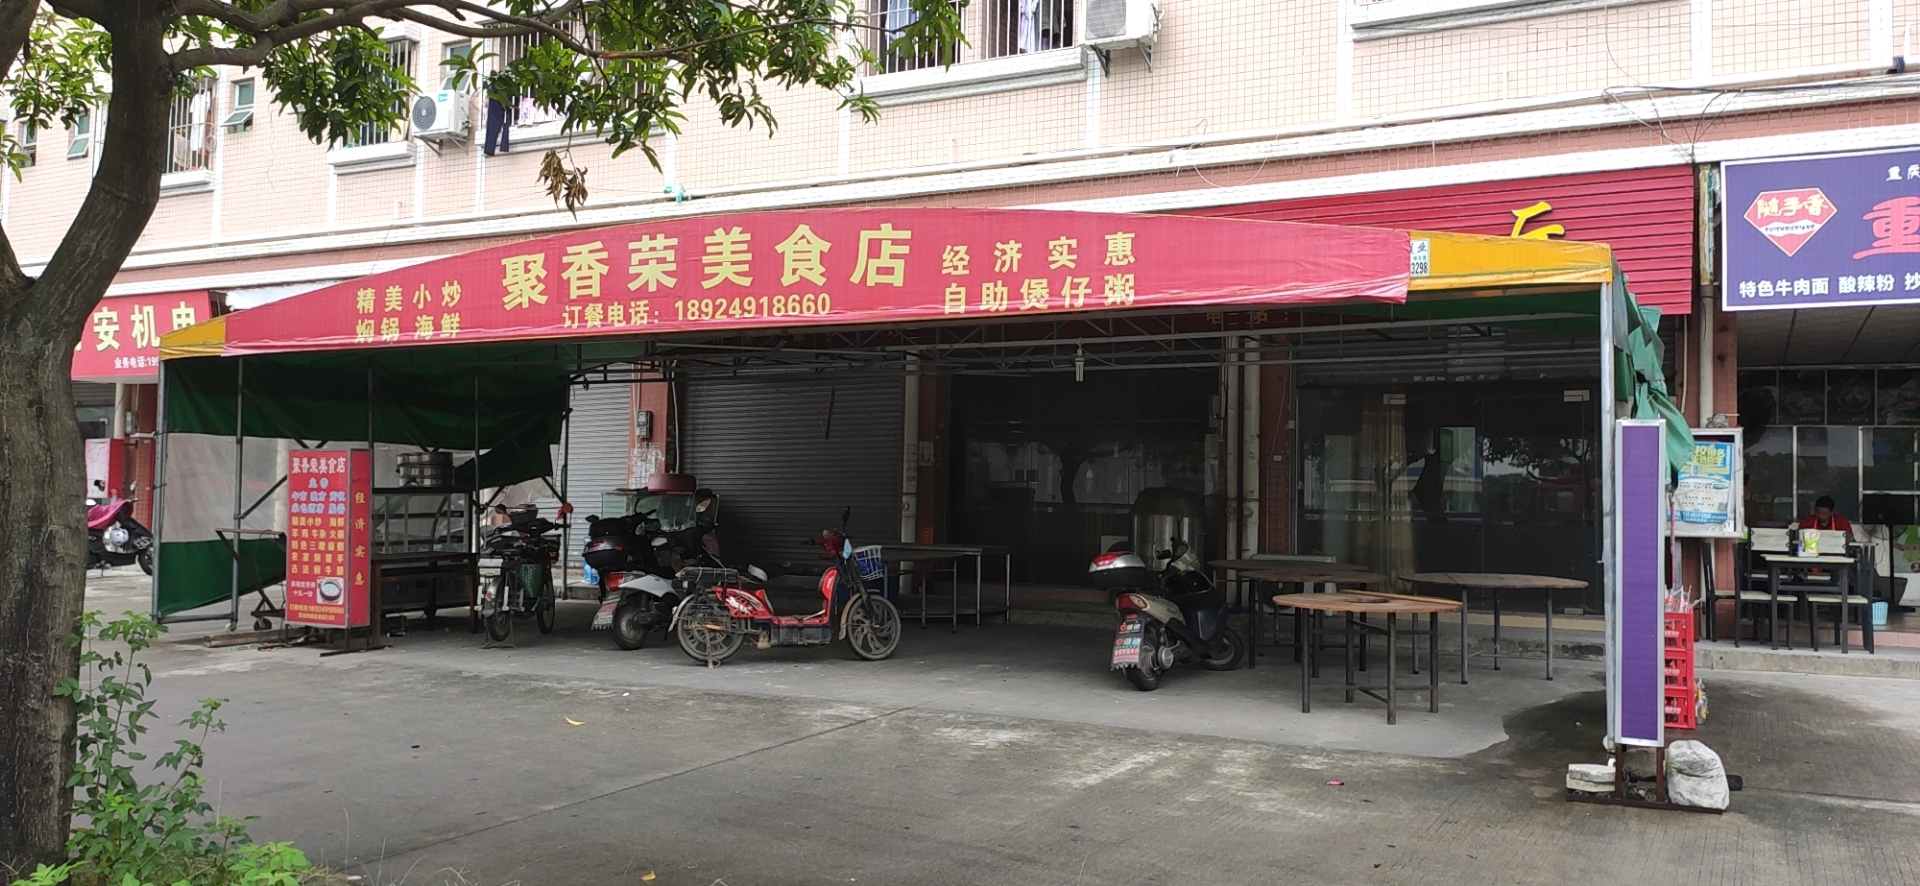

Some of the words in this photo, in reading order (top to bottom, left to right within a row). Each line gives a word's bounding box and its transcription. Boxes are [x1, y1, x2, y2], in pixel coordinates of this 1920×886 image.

[1757, 193, 1828, 219] 随手香
[501, 222, 912, 311] 聚香荣美食店
[941, 230, 1136, 276] 经济实惠
[356, 280, 462, 314] 精美小炒
[943, 272, 1135, 315] 自助煲仔粥
[1739, 277, 1829, 298] 特色牛肉面
[1838, 274, 1895, 294] 酸辣粉
[354, 317, 400, 344] 焖锅
[414, 312, 461, 340] 海鲜
[291, 456, 346, 474] 聚香荣美食店
[291, 516, 322, 527] 精美小炒
[354, 491, 366, 586] 经济实惠
